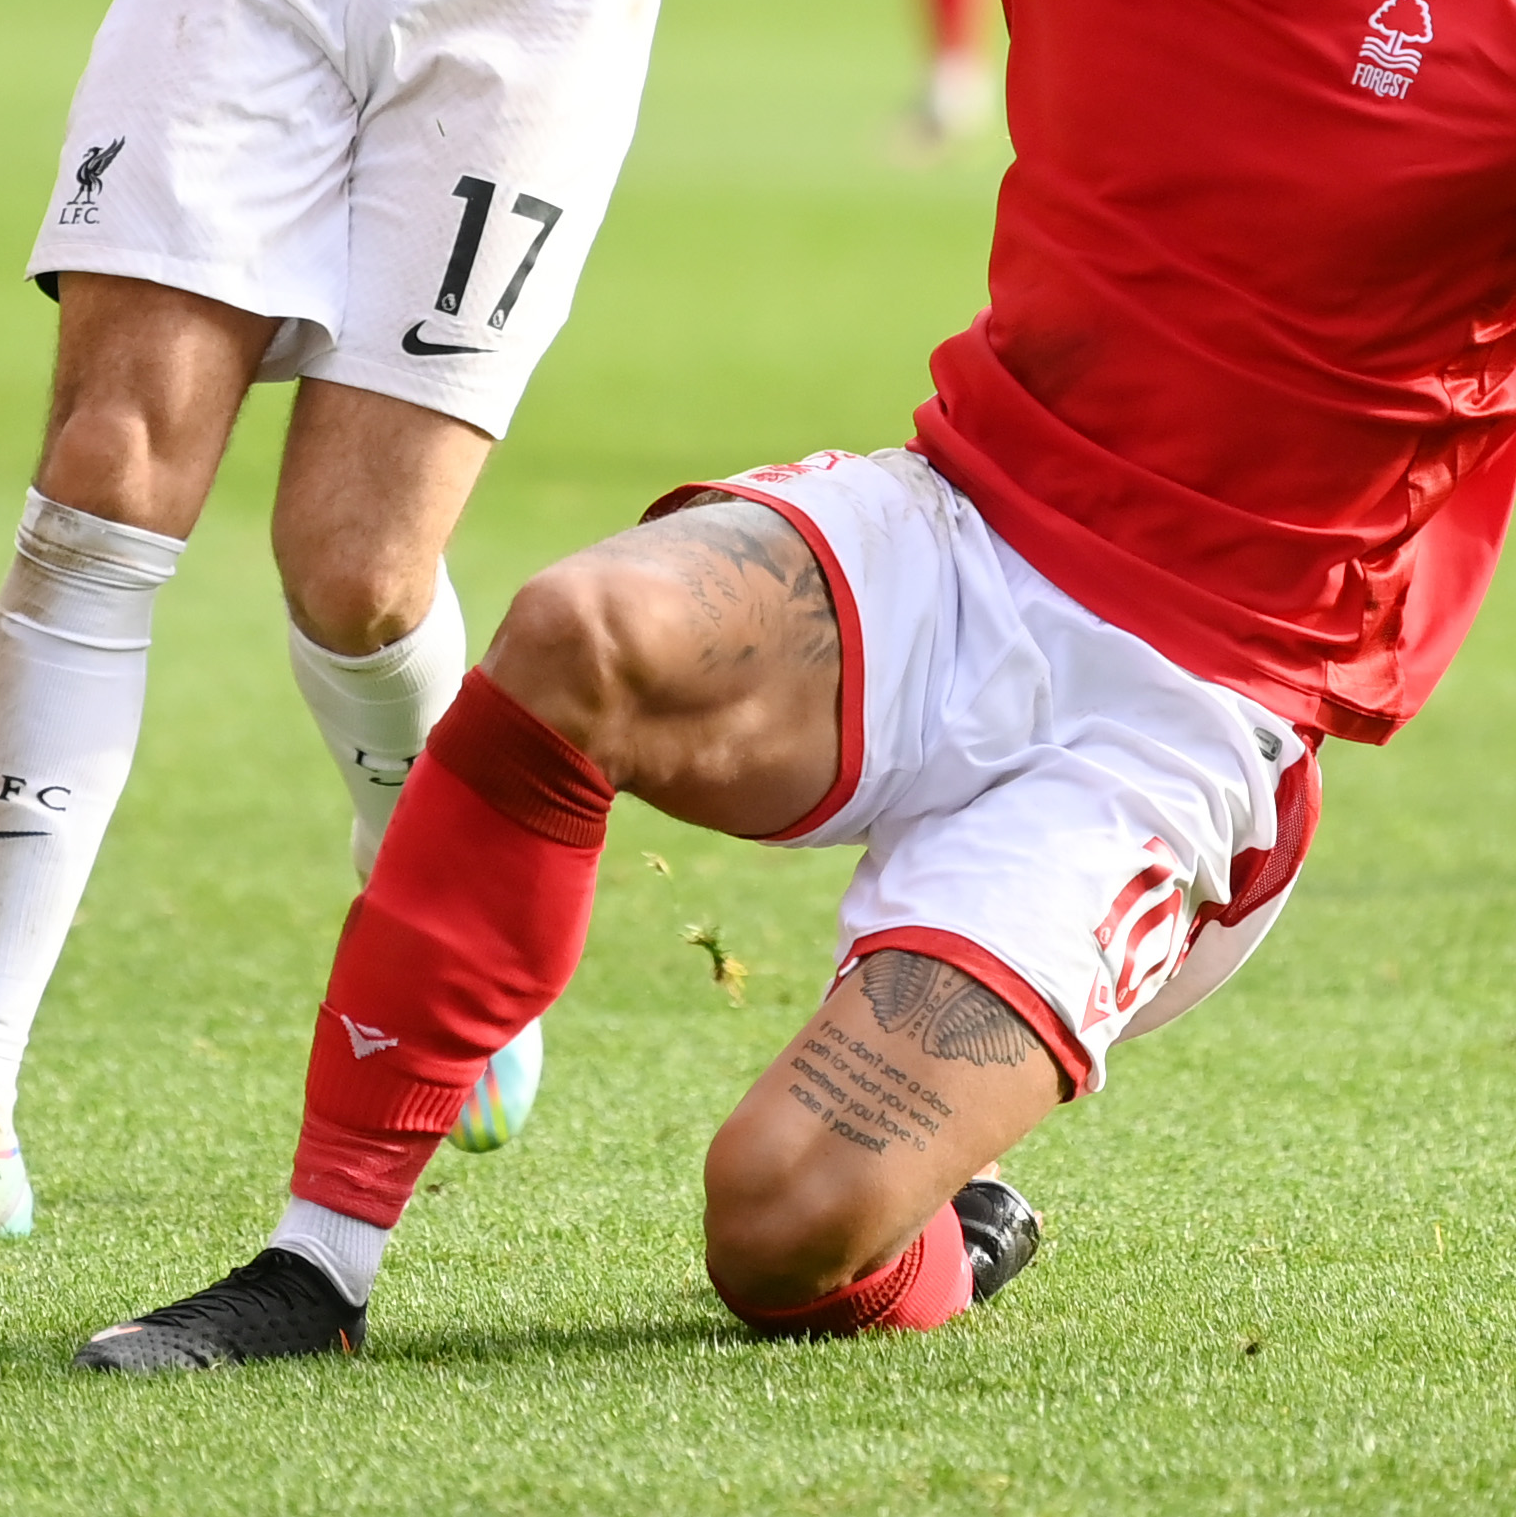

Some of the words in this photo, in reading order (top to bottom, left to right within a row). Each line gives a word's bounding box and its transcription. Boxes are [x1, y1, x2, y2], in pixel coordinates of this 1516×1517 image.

[434, 175, 564, 332] 17
[1092, 835, 1184, 1013] 10
[788, 1084, 823, 1114] make
[821, 1108, 834, 1123] it
[790, 1056, 849, 1105] sometimes
[843, 1098, 875, 1122] you
[874, 1110, 912, 1142] have
[912, 1135, 927, 1152] to
[802, 1038, 831, 1061] path
[830, 1052, 851, 1072] for
[849, 1071, 883, 1096] what
[877, 1091, 908, 1112] you
[823, 1027, 849, 1045] you
[880, 1064, 908, 1085] see
[907, 1081, 922, 1095] a
[920, 1090, 953, 1119] clear
